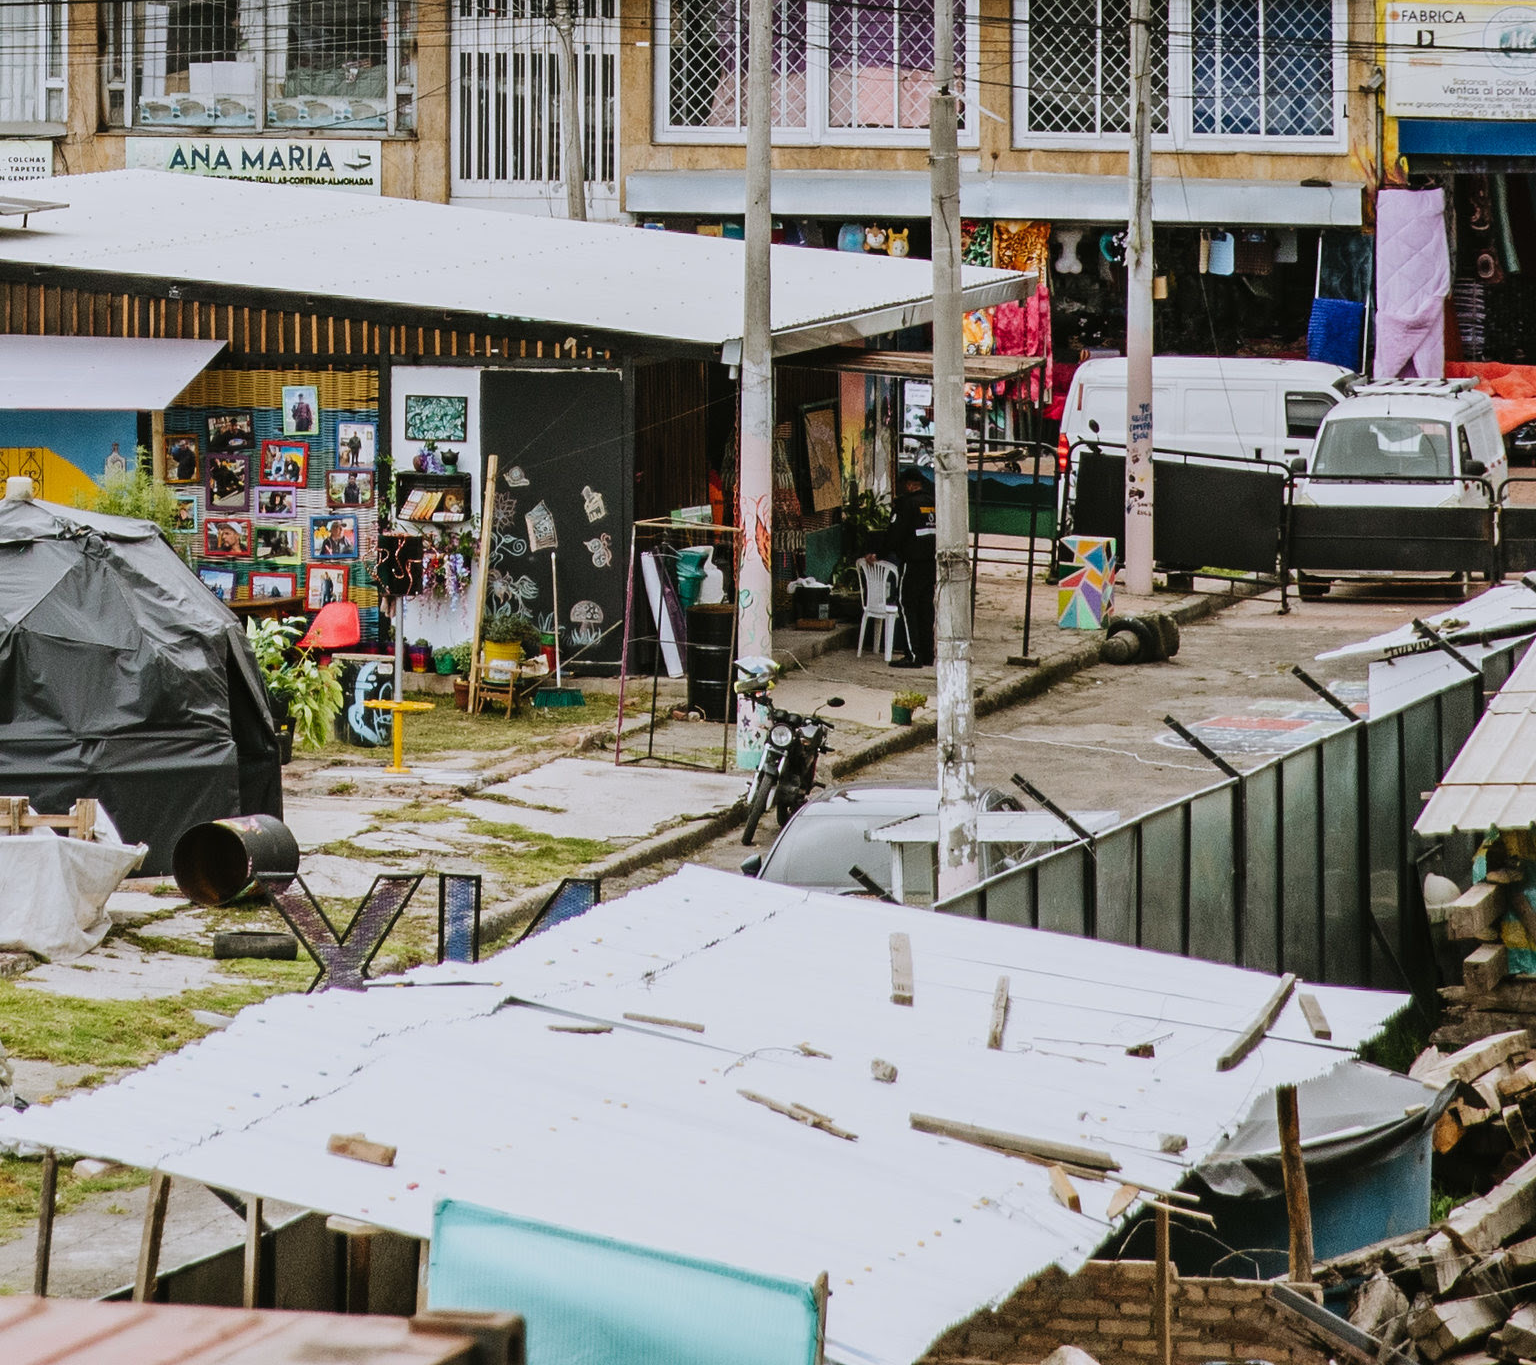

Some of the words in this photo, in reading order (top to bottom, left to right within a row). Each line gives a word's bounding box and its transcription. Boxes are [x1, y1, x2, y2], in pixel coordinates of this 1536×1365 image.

[1401, 10, 1466, 23] FABRICA
[1442, 85, 1480, 95] Ventas
[1482, 87, 1494, 95] al
[1496, 88, 1515, 97] por
[168, 144, 233, 171] ANA
[241, 145, 335, 172] MARIA
